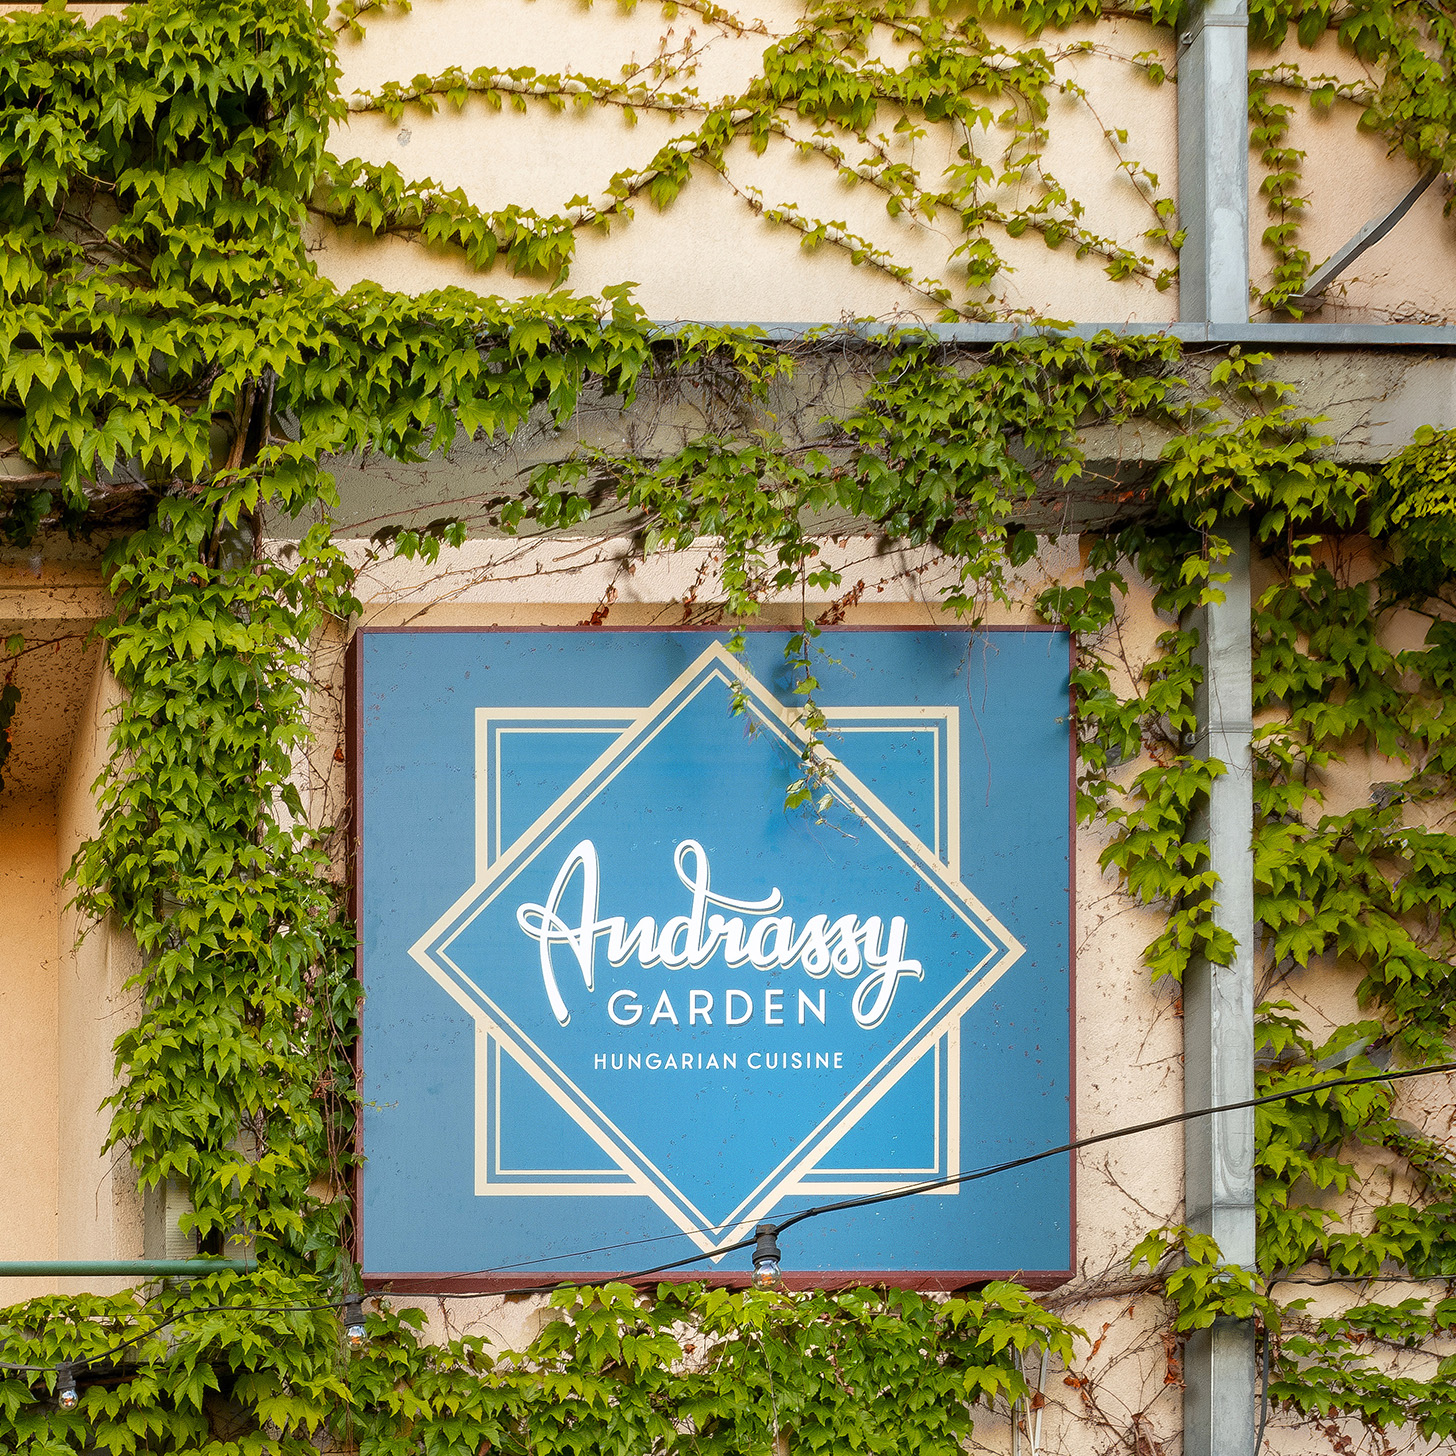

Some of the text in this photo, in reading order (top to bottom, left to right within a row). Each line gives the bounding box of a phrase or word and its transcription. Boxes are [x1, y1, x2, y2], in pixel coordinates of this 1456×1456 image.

[516, 838, 924, 1031] Andrassy
[607, 988, 828, 1027] GARDEN
[593, 1051, 844, 1071] HUNGARIAN CUISINE
